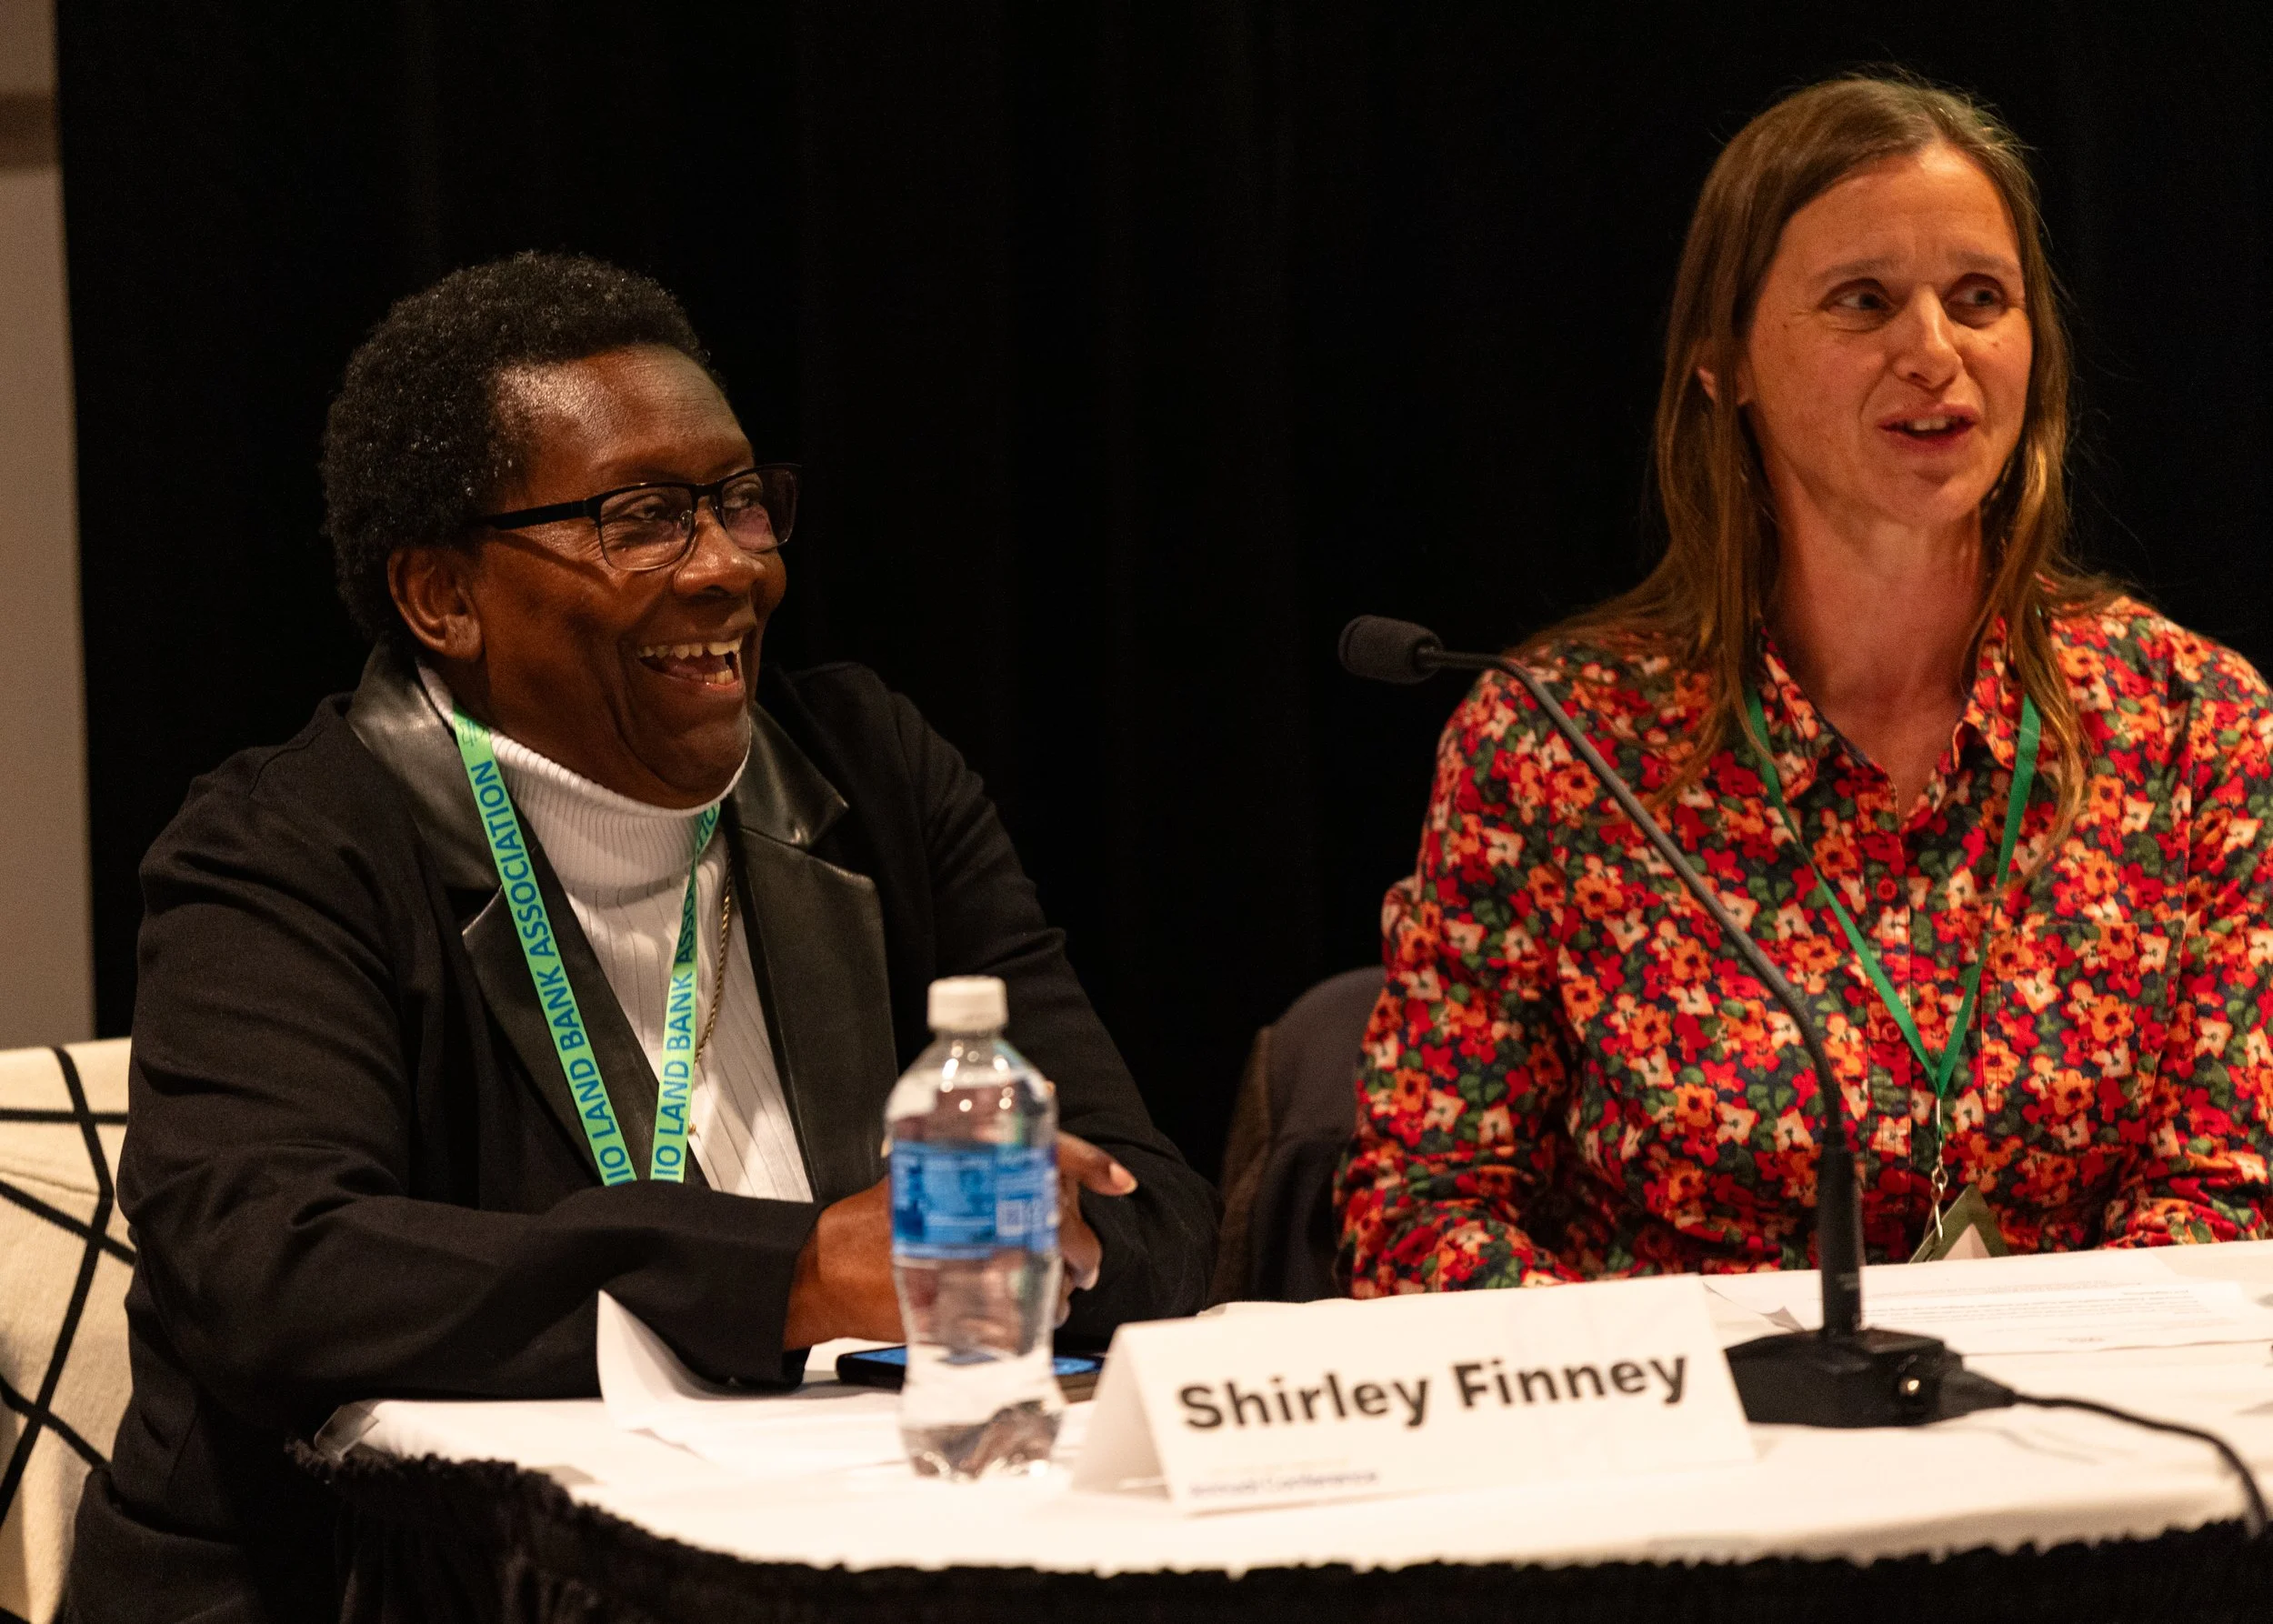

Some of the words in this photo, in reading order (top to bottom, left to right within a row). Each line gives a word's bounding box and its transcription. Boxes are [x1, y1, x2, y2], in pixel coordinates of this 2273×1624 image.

[471, 761, 556, 957] ASSOCIATION
[537, 970, 586, 1051] BANK
[667, 972, 693, 1051] BANK
[570, 1058, 616, 1138] LAND
[658, 1061, 689, 1136] LAND
[600, 1146, 633, 1186] IO
[655, 1145, 682, 1181] IO
[1179, 1372, 1430, 1429] Shirley
[1452, 1355, 1687, 1408] Finney
